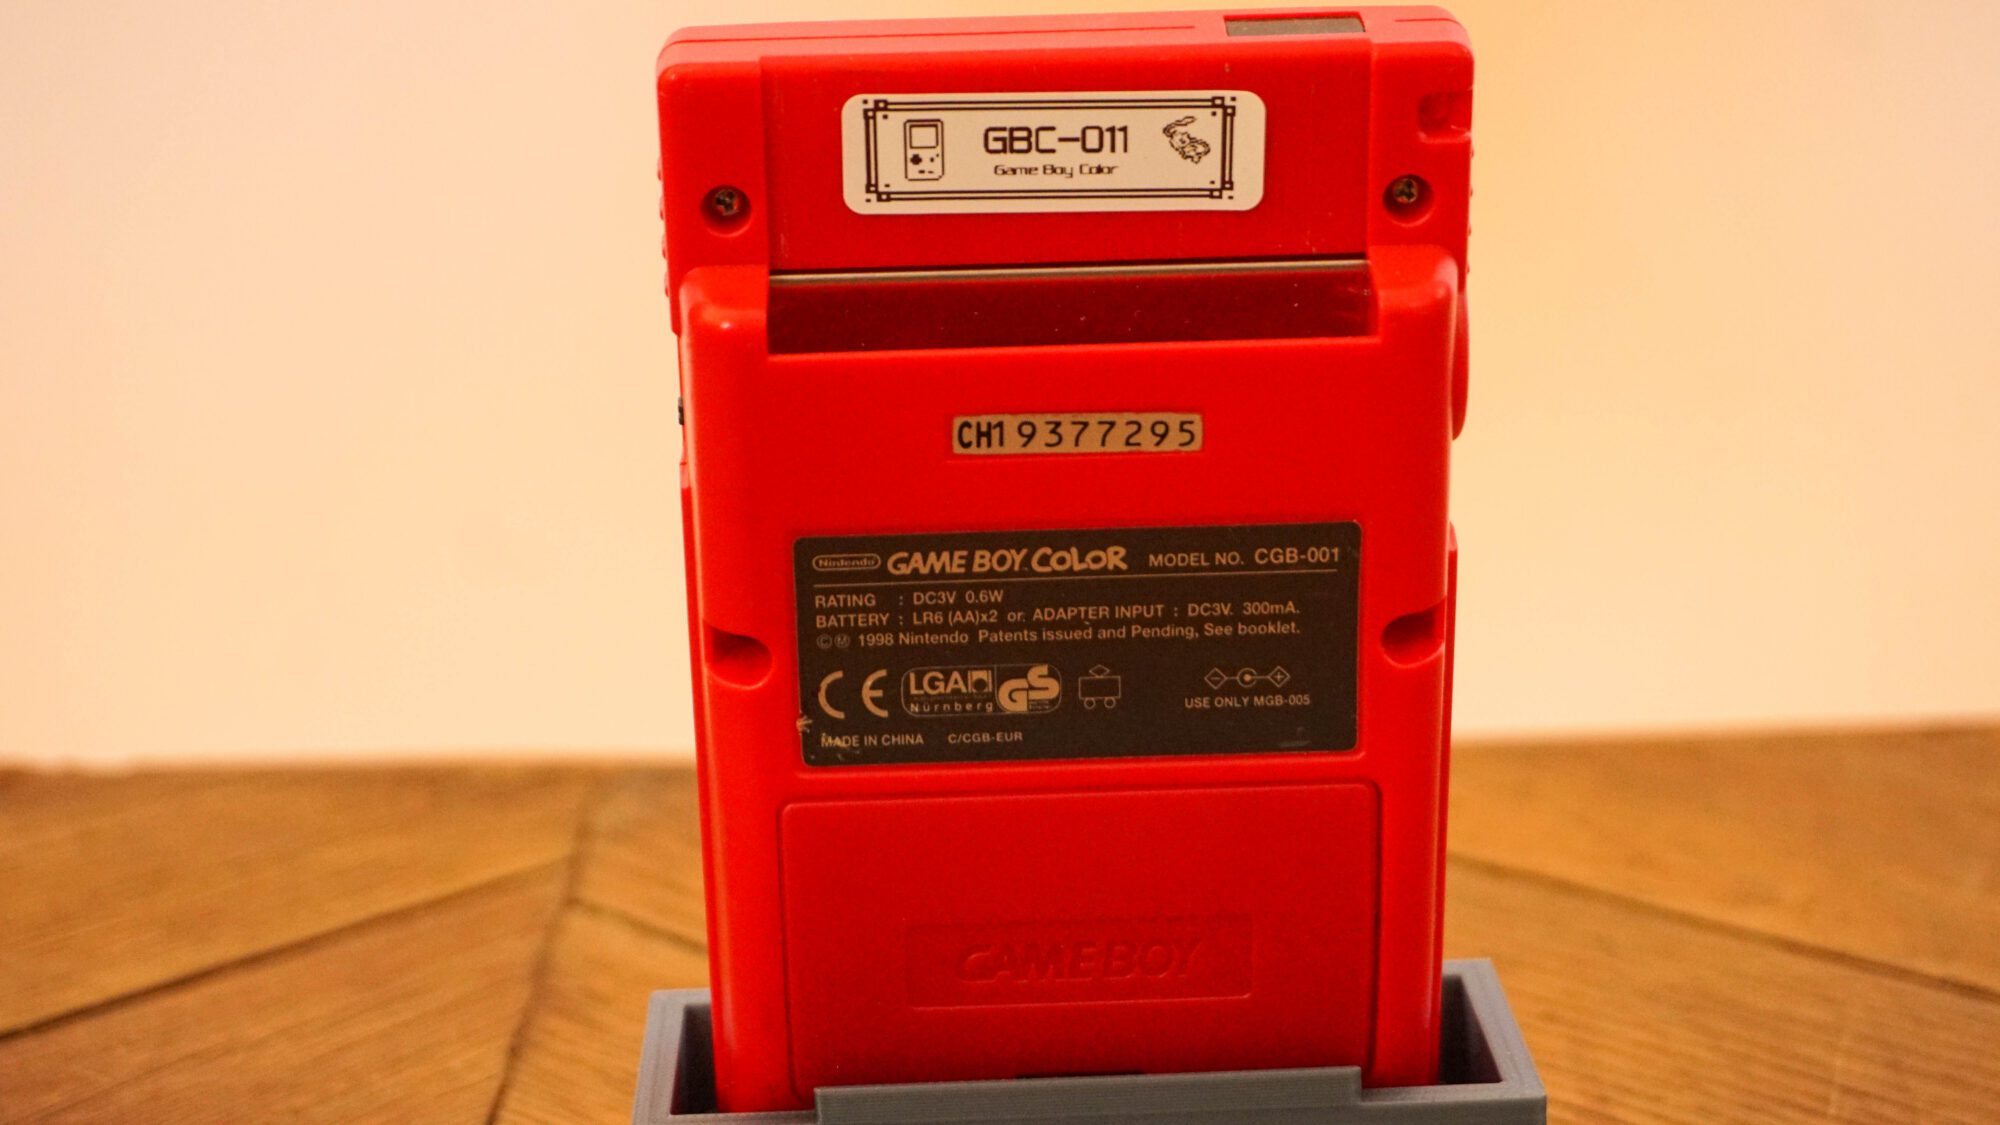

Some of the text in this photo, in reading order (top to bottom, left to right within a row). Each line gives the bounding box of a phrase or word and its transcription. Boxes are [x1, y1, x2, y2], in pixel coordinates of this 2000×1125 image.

[983, 125, 1128, 155] GBC-011
[994, 163, 1118, 178] Game Boy Color
[818, 545, 1339, 576] Nintendo GAME BOY COLOR MODEL NO. CGB-001
[815, 593, 876, 608] RATING
[913, 591, 956, 605] DC3V
[965, 589, 1004, 603] 0.6W
[816, 613, 890, 628] BATTERY
[913, 612, 943, 625] LR6
[948, 610, 998, 626] (AA)x2
[1032, 605, 1110, 622] ADAPTER
[1114, 604, 1165, 618] INPUT
[1242, 600, 1300, 615] 300mA.
[858, 633, 894, 647] 1998
[899, 631, 969, 646] Nintendo
[978, 627, 1037, 642] Patents
[1042, 625, 1093, 641] issued
[1098, 624, 1126, 639] and
[1131, 621, 1200, 640] Pending,
[1203, 622, 1233, 636] See
[1238, 619, 1300, 635] booklet.
[909, 671, 967, 695] LGA
[910, 701, 994, 713] Nürnberg
[1185, 693, 1311, 709] USE ONLY MGB-005
[821, 731, 1023, 747] MADE IN CHINA C/CGB-EUR
